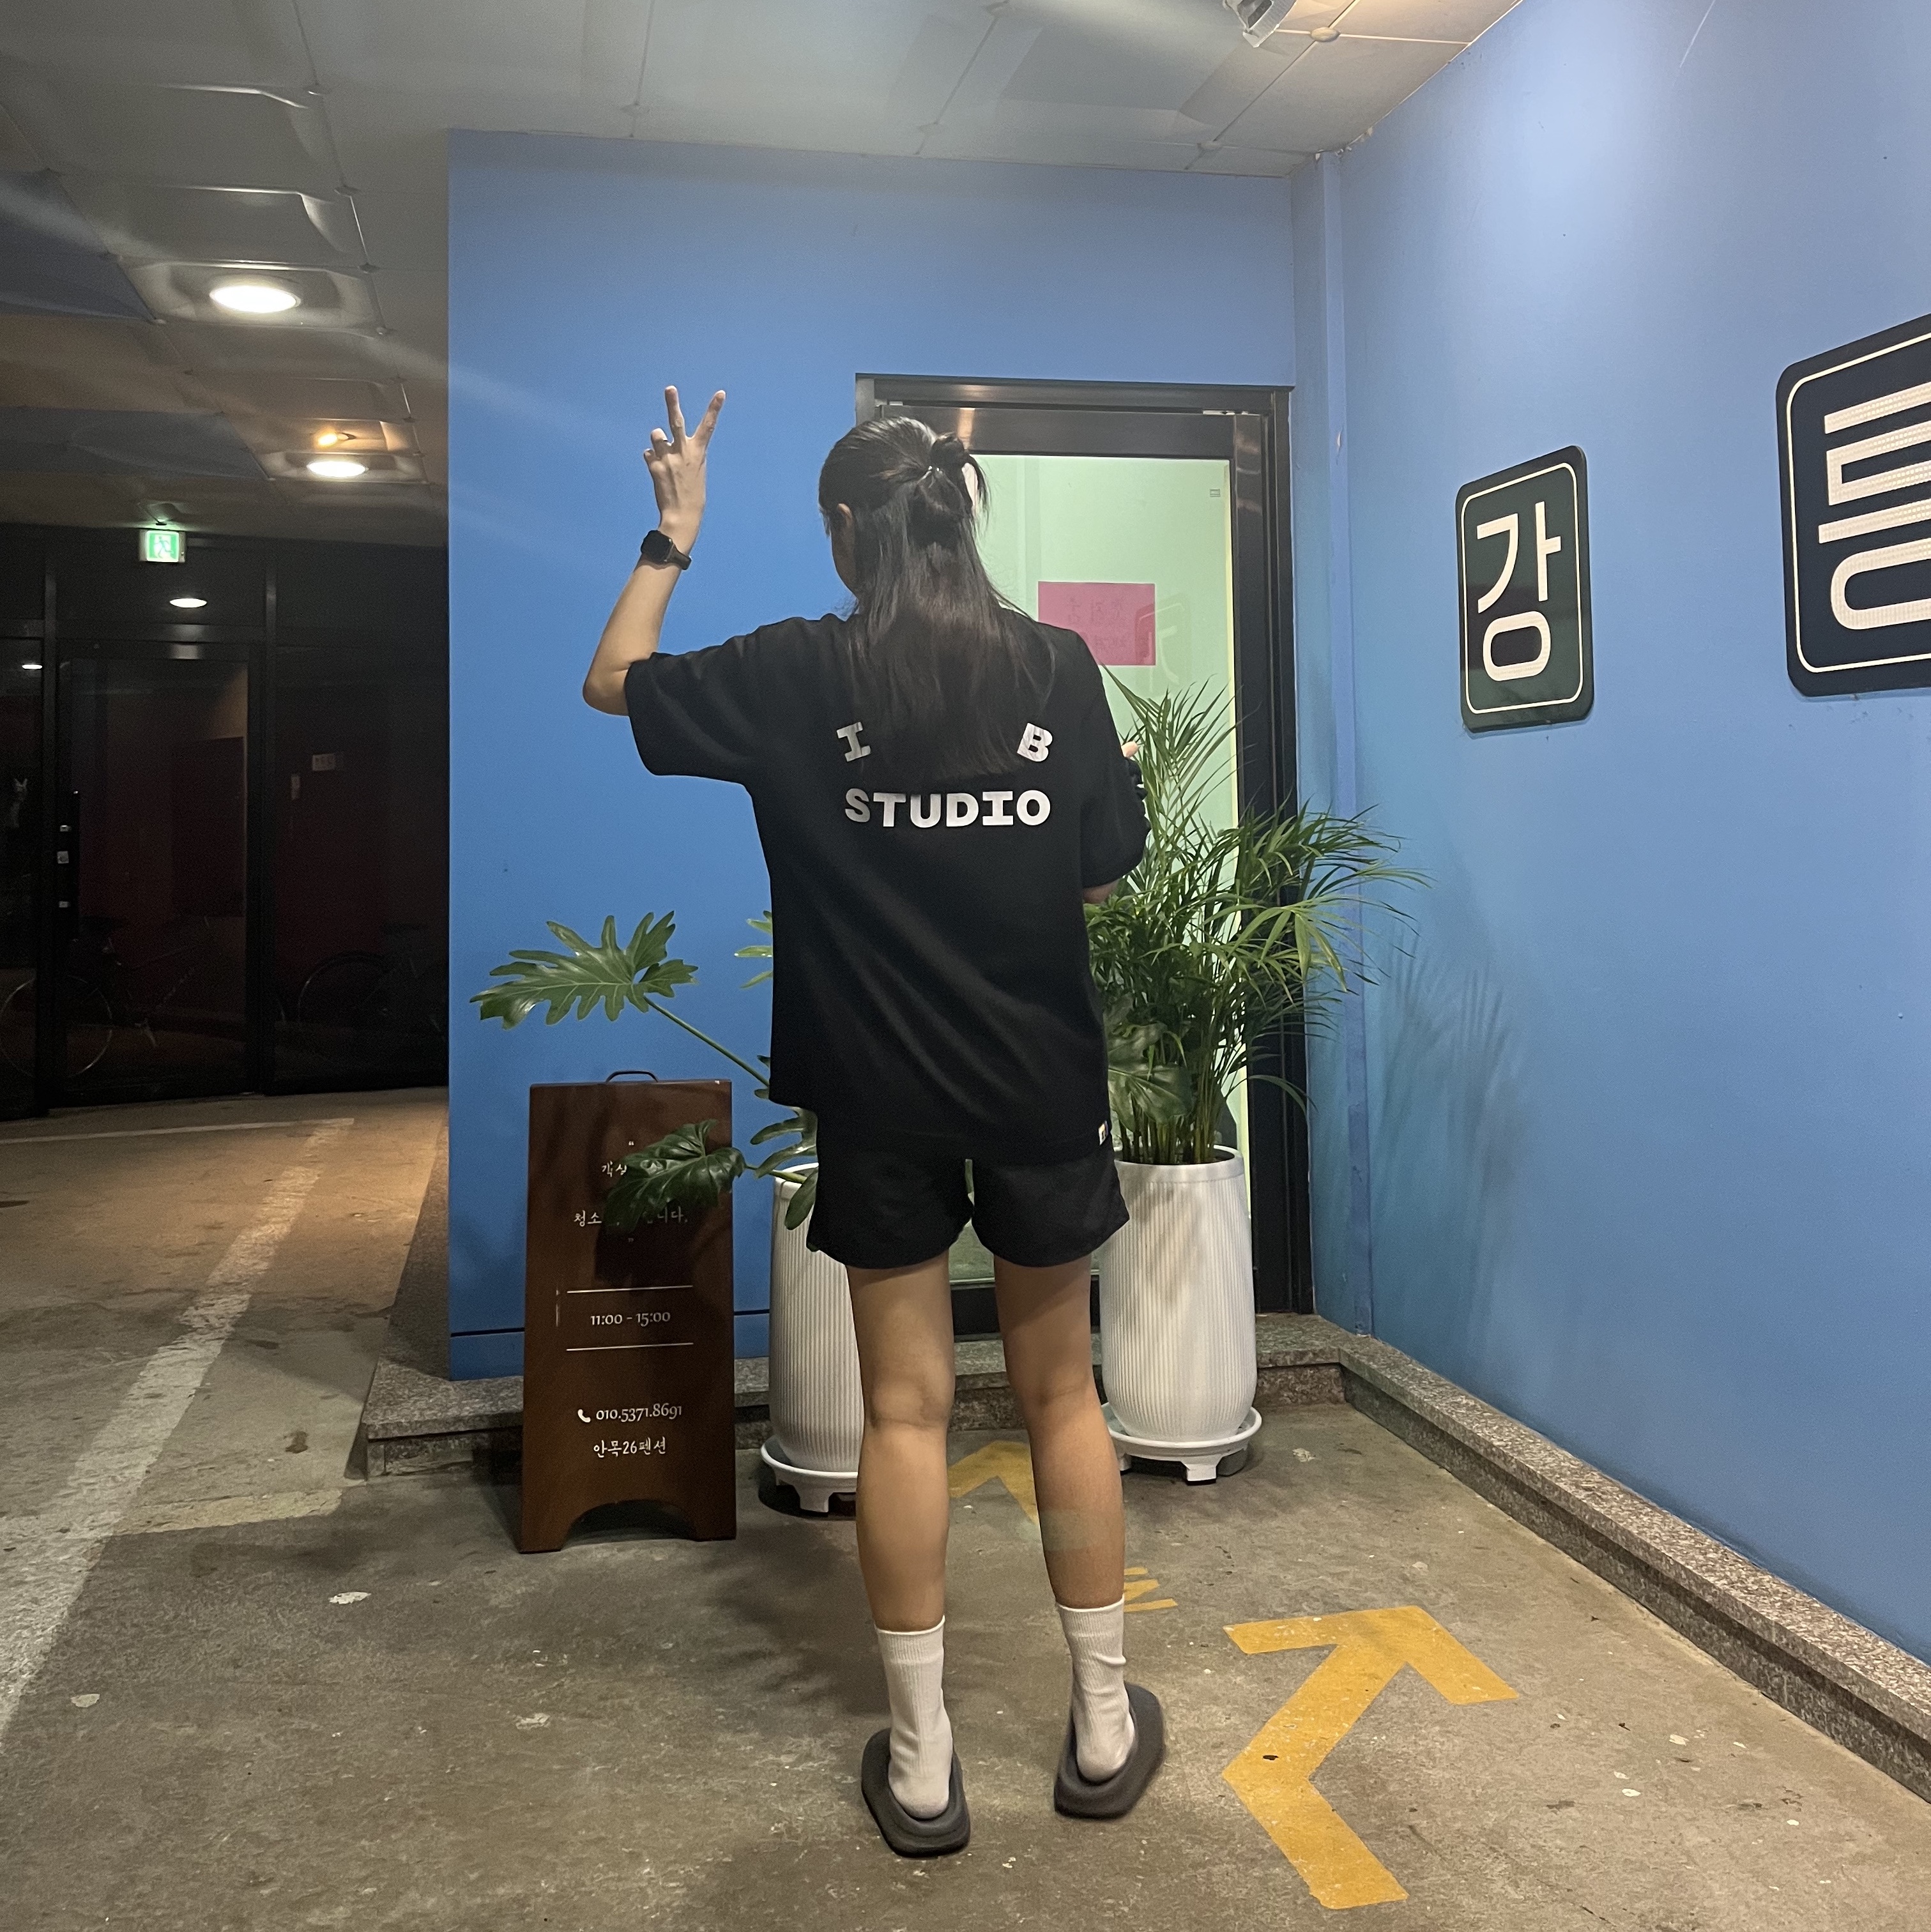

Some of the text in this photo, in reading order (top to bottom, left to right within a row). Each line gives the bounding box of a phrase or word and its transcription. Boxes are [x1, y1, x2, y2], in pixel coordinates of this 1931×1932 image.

[1476, 501, 1562, 682] 강
[1016, 722, 1053, 763] B
[844, 787, 1051, 828] STUDIO
[590, 1314, 623, 1325] 11:00
[636, 1311, 671, 1327] 15:00
[595, 1402, 682, 1422] 010.5371.8691
